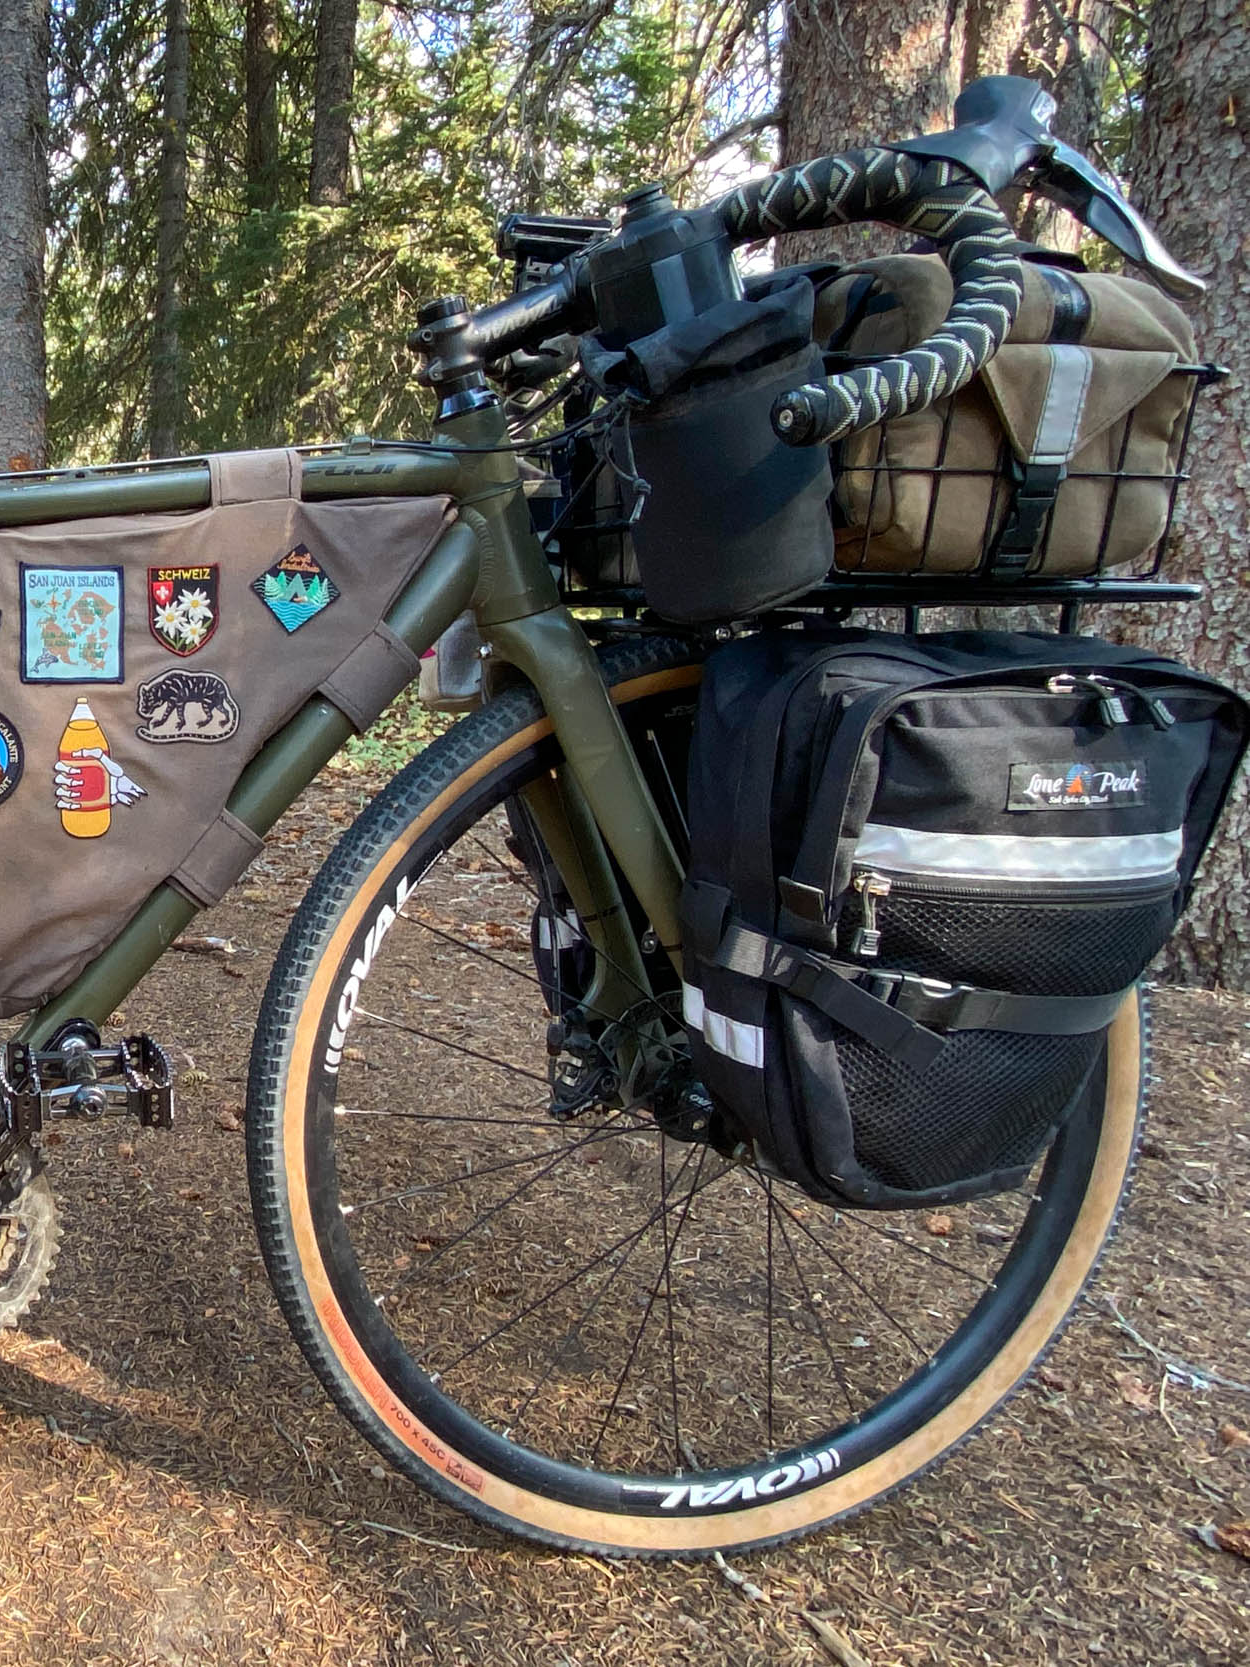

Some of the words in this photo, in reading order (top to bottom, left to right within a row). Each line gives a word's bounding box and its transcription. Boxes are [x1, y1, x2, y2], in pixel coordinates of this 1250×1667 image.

[29, 574, 49, 589] SAN
[51, 575, 76, 587] JUAN
[77, 576, 115, 588] ISLANDS
[158, 569, 211, 581] SCHWEIZ
[1023, 773, 1064, 799] Lone
[1092, 769, 1141, 793] Peak
[336, 875, 418, 1032] OVAL
[389, 1402, 411, 1428] 700
[421, 1436, 446, 1460] 45C
[656, 1464, 802, 1509] OVAL
